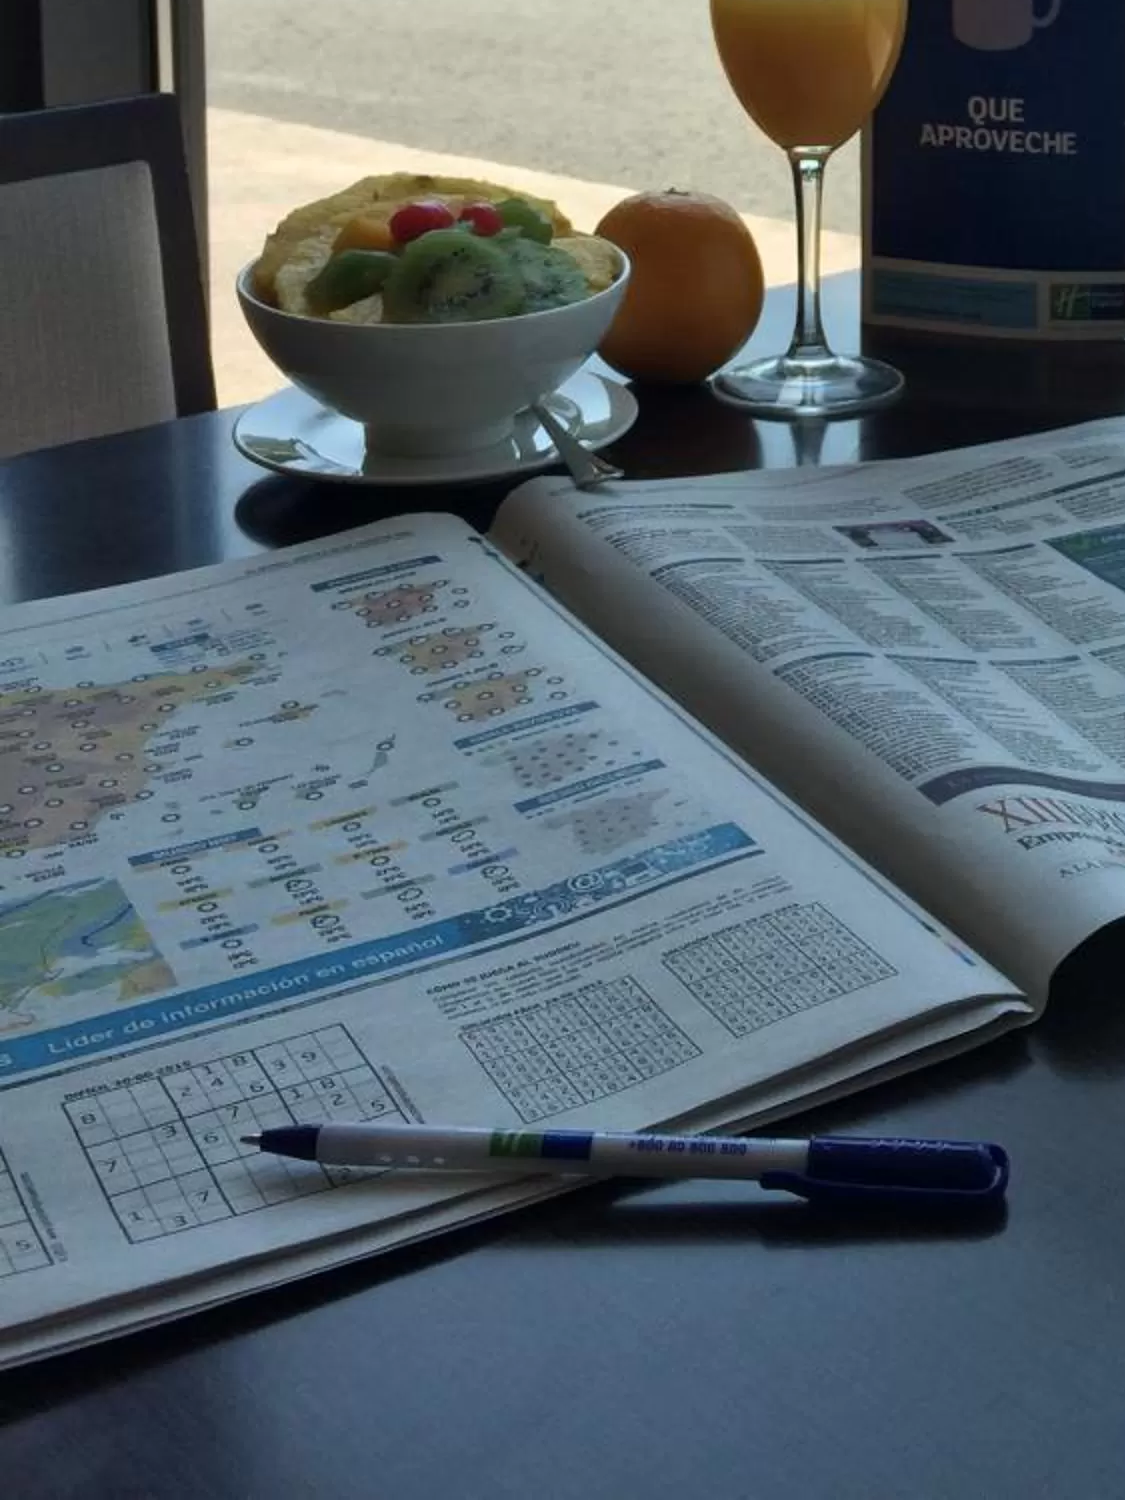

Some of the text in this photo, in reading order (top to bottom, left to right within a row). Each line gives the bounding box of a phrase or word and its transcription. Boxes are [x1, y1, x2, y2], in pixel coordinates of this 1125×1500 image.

[967, 95, 1025, 125] QUE
[919, 122, 1078, 155] APROVECHE
[161, 974, 311, 1022] información
[316, 962, 346, 977] en
